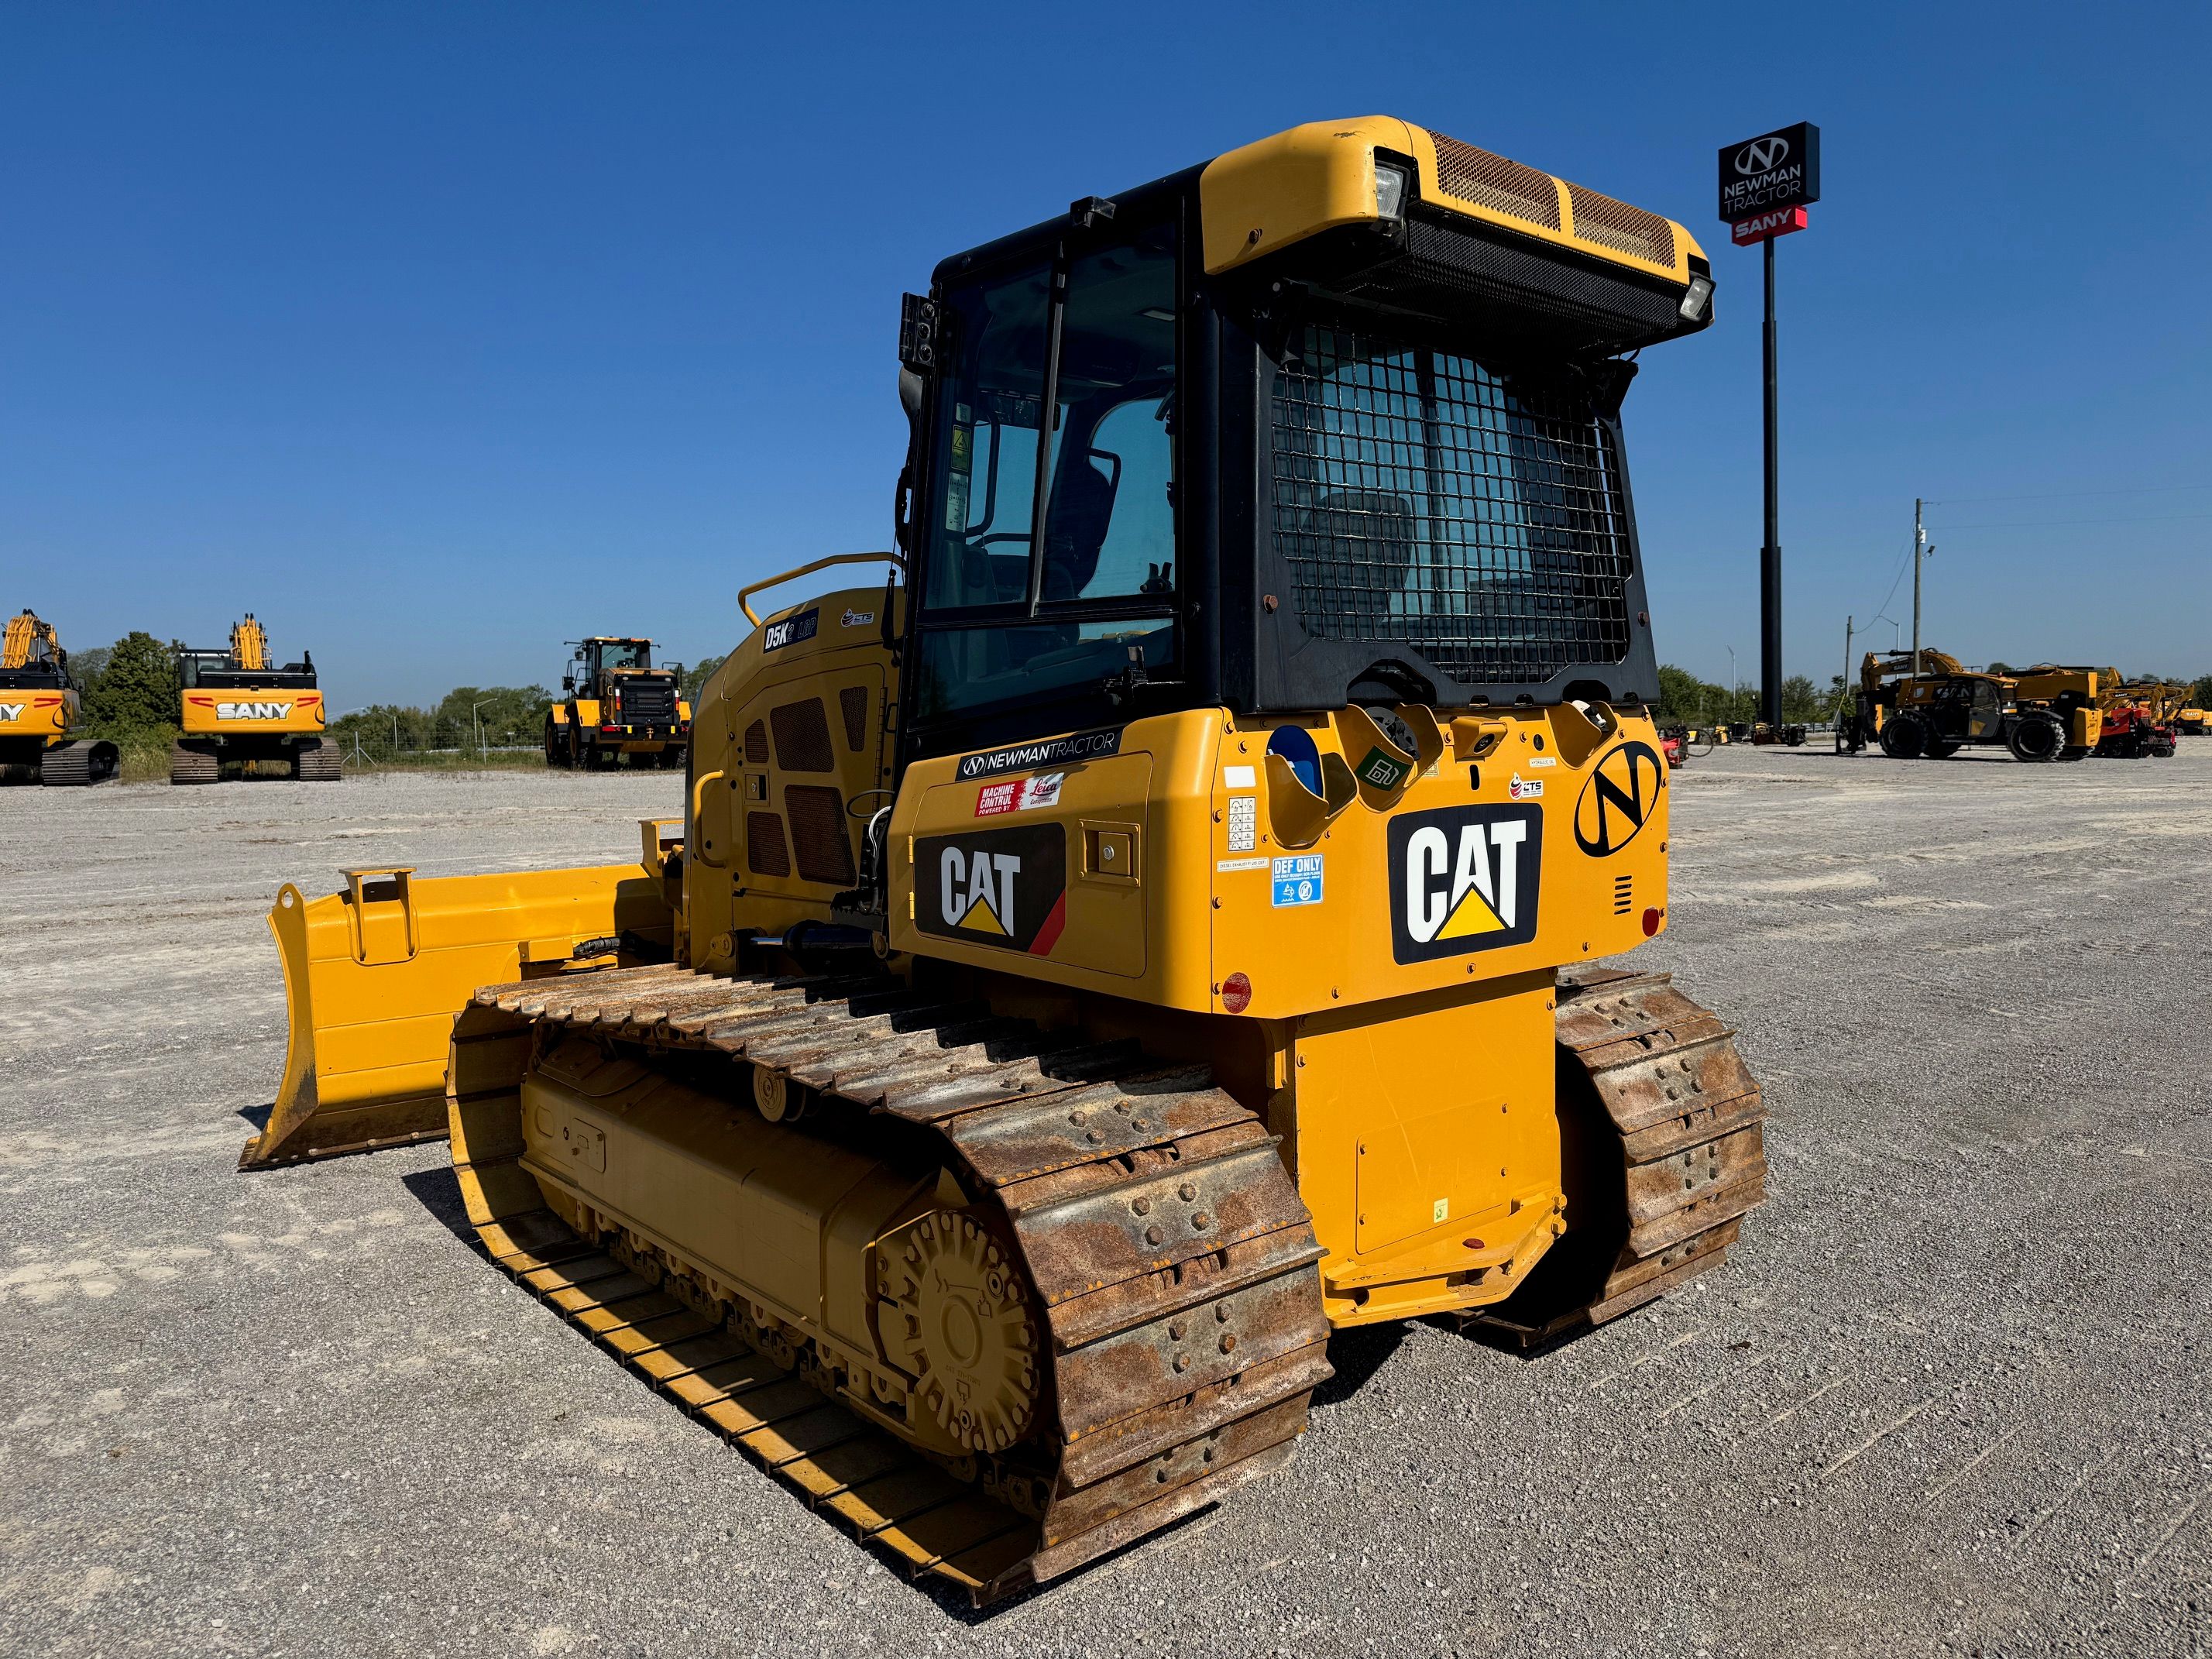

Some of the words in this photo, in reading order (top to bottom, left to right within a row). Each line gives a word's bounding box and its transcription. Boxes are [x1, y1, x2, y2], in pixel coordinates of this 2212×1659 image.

[1724, 164, 1801, 199] NEWMAN
[1724, 180, 1801, 214] TRACTOR
[1735, 208, 1792, 238] SANY
[216, 702, 294, 720] SANY
[982, 784, 1015, 799] MACHINE
[1029, 778, 1057, 796] Leica
[1523, 782, 1541, 791] CTS
[980, 795, 1012, 809] CONTROL
[978, 807, 1002, 816] POWERED
[1275, 860, 1293, 874] DEF
[1297, 857, 1321, 873] ONLY
[1407, 819, 1527, 943] CAT
[940, 846, 1021, 937] CAT
